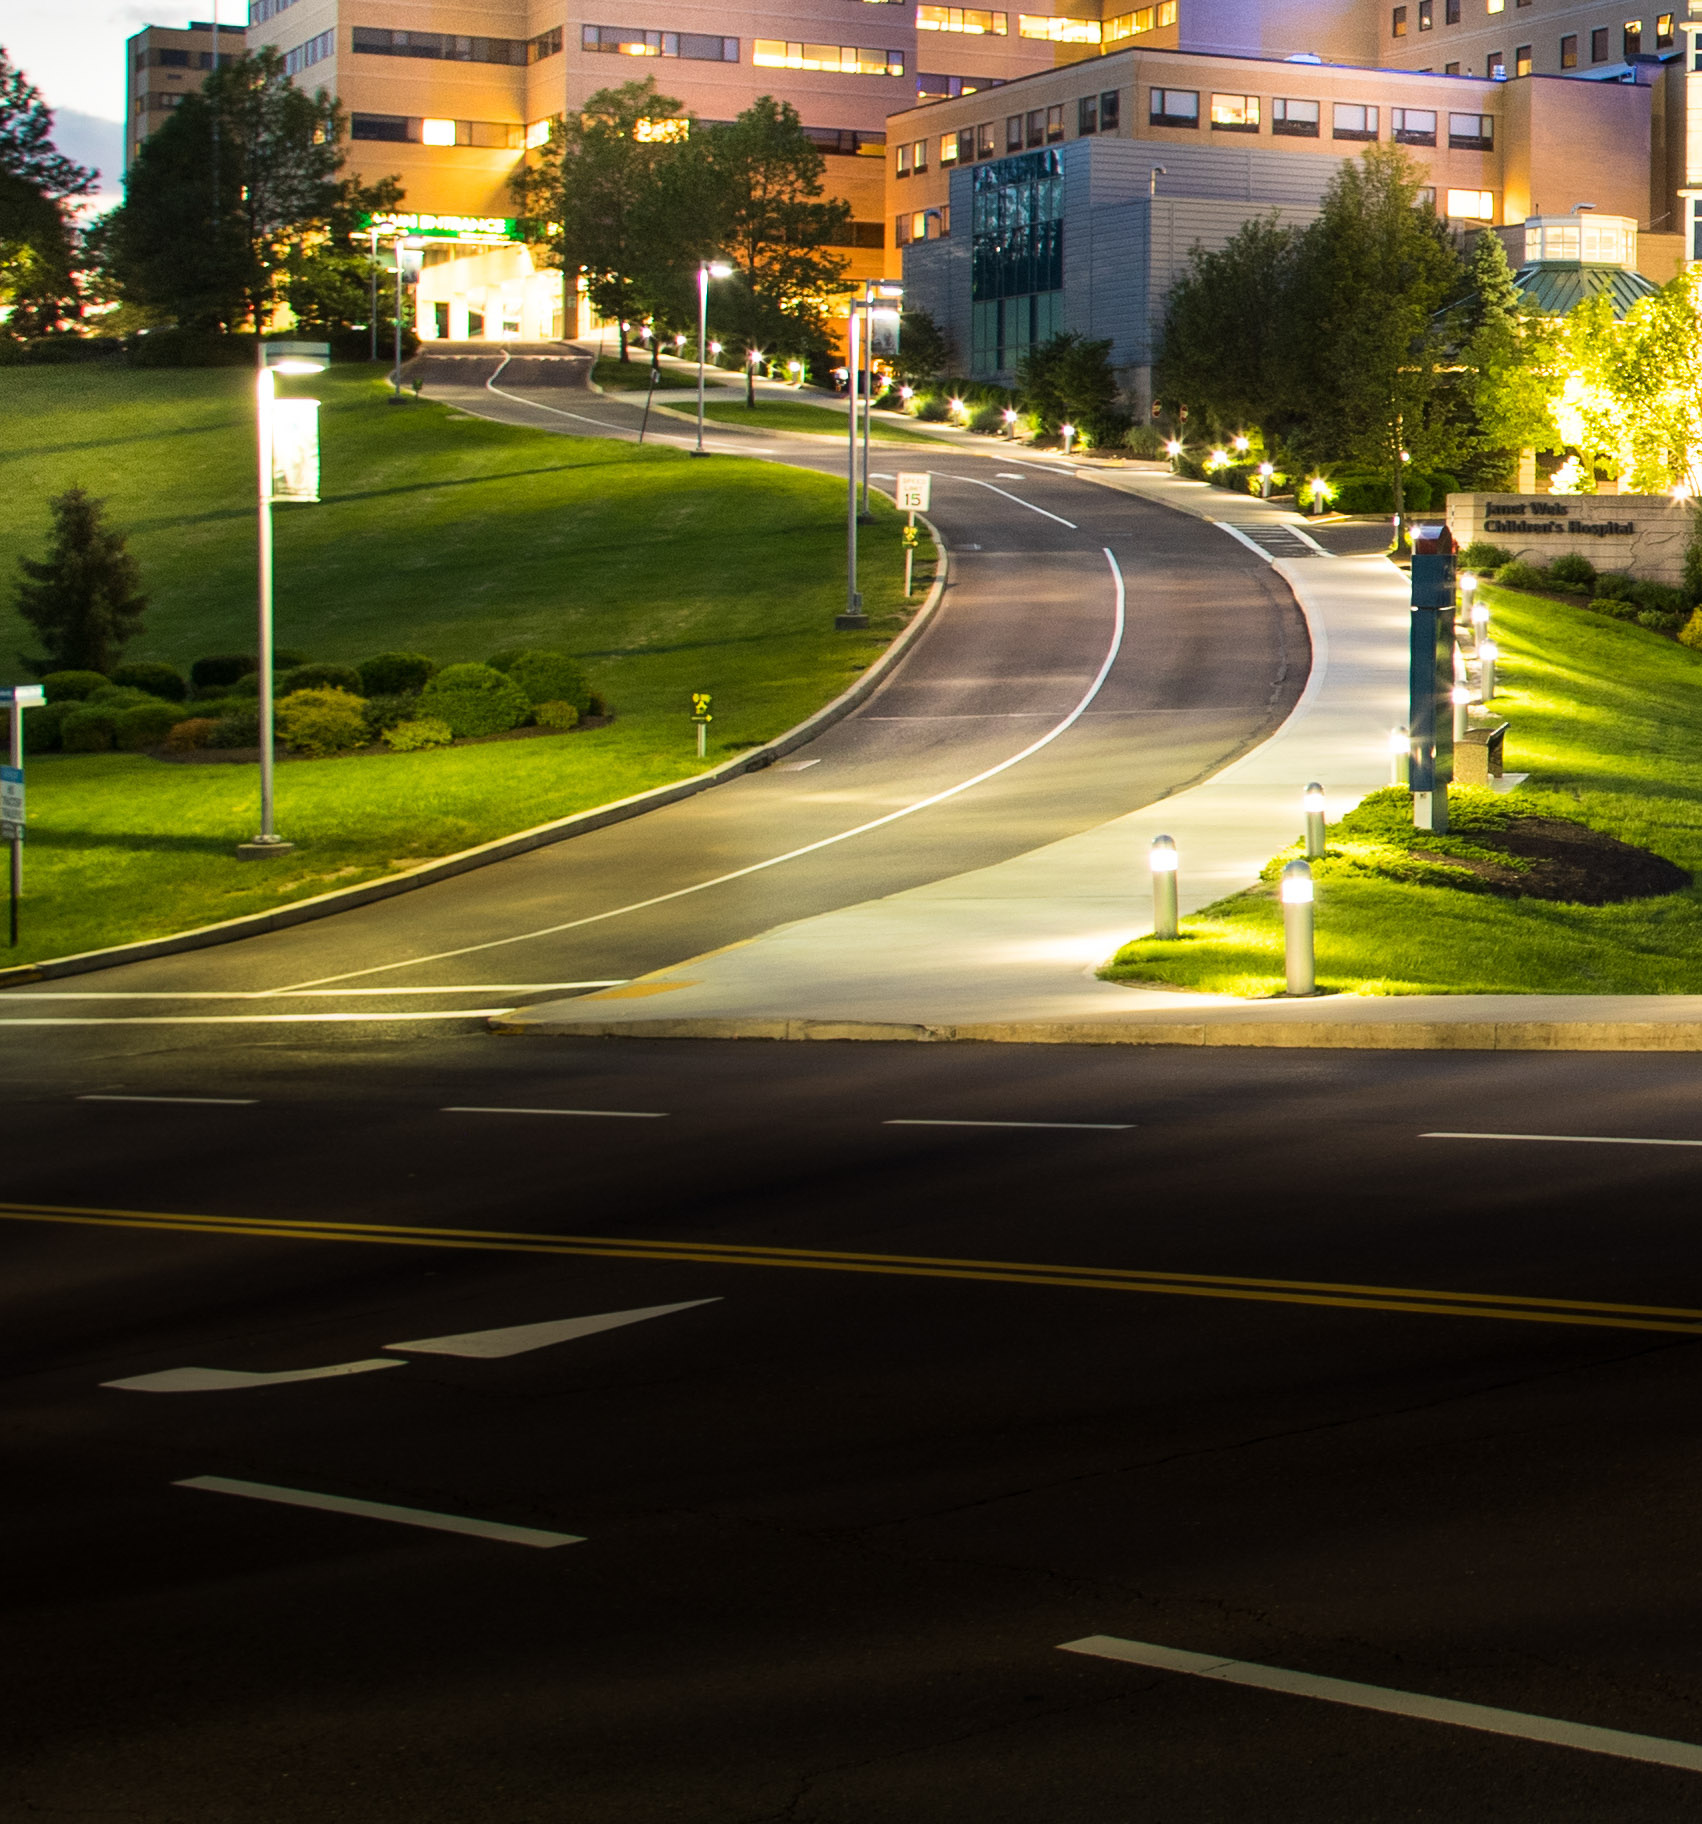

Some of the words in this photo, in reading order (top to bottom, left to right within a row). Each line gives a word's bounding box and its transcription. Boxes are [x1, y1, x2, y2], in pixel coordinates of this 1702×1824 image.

[419, 214, 506, 233] ENTRANCE
[905, 493, 921, 506] 15
[1484, 501, 1526, 518] Janet
[1529, 501, 1568, 516] Weis
[1483, 519, 1564, 533] Children's
[1568, 520, 1634, 537] Hospital
